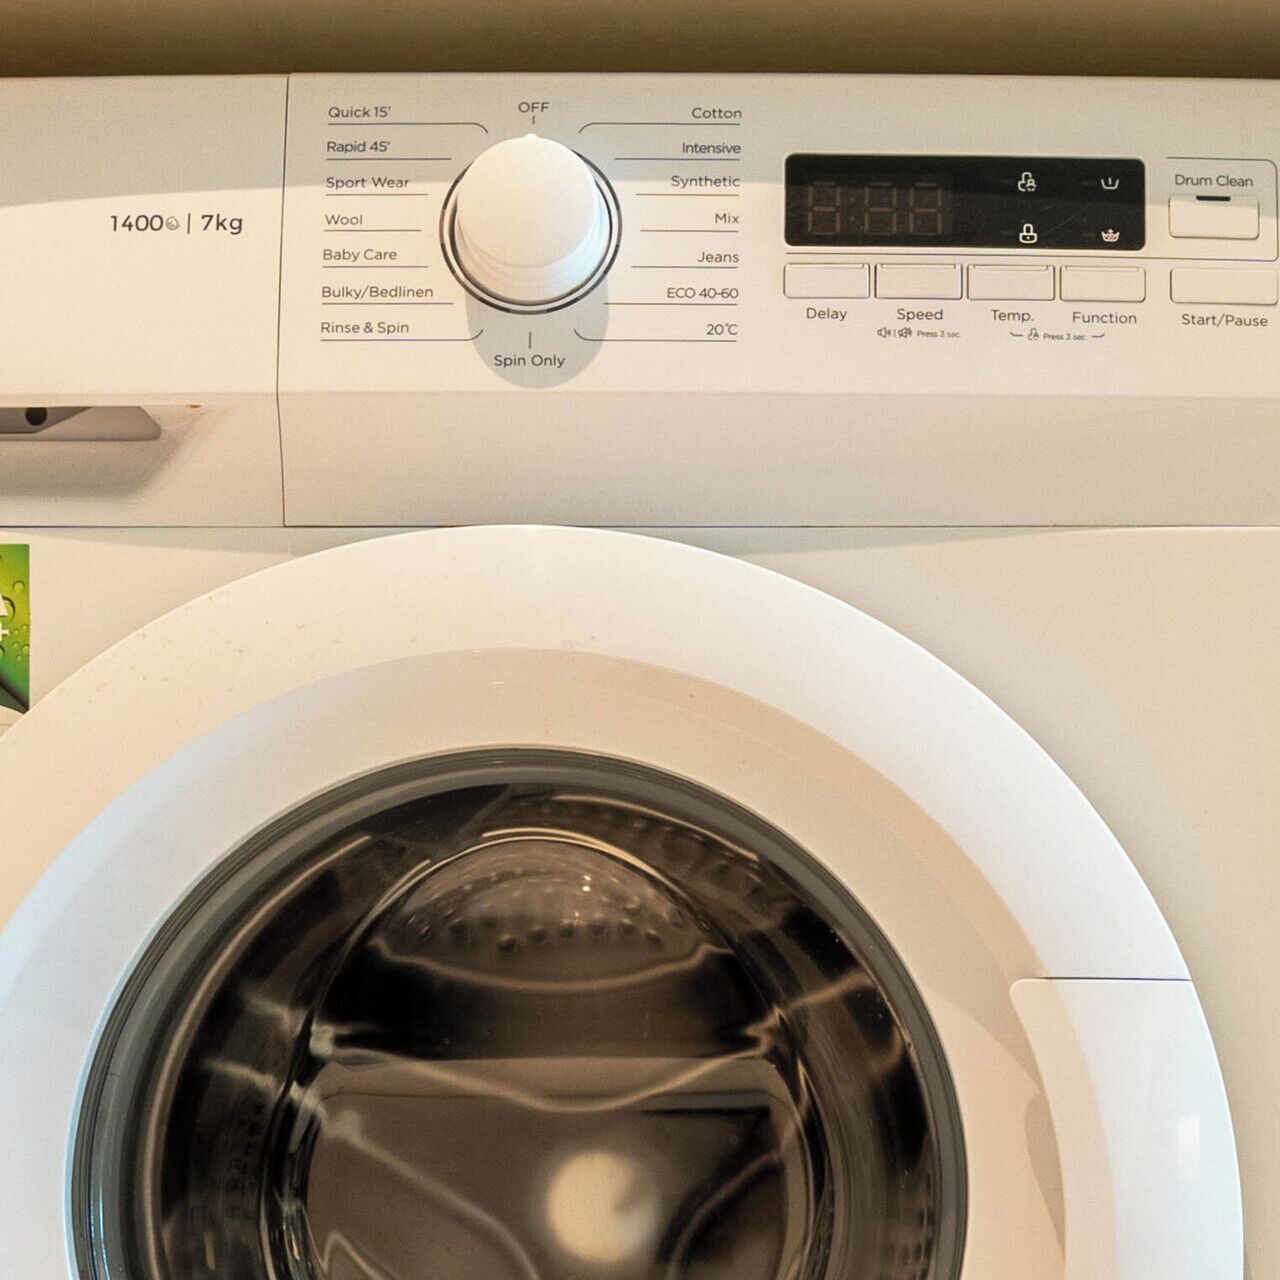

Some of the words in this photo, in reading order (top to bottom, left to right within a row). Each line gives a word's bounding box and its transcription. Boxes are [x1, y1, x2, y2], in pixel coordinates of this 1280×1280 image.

[327, 106, 371, 119] Quick
[517, 101, 550, 114] OFF
[691, 106, 743, 119] Cotton
[326, 140, 367, 155] Rapid
[681, 142, 742, 154] Intensive
[325, 176, 367, 190] Sport
[371, 176, 411, 188] Wear
[670, 174, 741, 189] Synthetic
[1174, 173, 1213, 187] Drum
[1215, 174, 1254, 188] Clean
[110, 214, 164, 232] 1400
[201, 213, 243, 236] 7kg
[324, 213, 363, 226] Wool
[714, 212, 740, 225] Mix
[322, 248, 360, 263] Baby
[363, 248, 398, 261] Care
[697, 251, 740, 263] Jeans
[321, 284, 434, 301] Bulky/Bedlinen
[666, 287, 696, 299] ECO
[698, 287, 739, 300] 40-60
[806, 307, 848, 322] Delay
[896, 307, 944, 323] Speed
[990, 309, 1034, 324] Temp.
[1072, 311, 1137, 325] Function
[1181, 313, 1269, 327] Start/Pause
[320, 321, 361, 334] Rinse
[363, 321, 374, 334] &
[377, 321, 410, 336] Spin
[916, 329, 938, 339] Press
[1042, 332, 1065, 342] Press
[493, 354, 526, 369] Spin
[530, 354, 566, 369] Only
